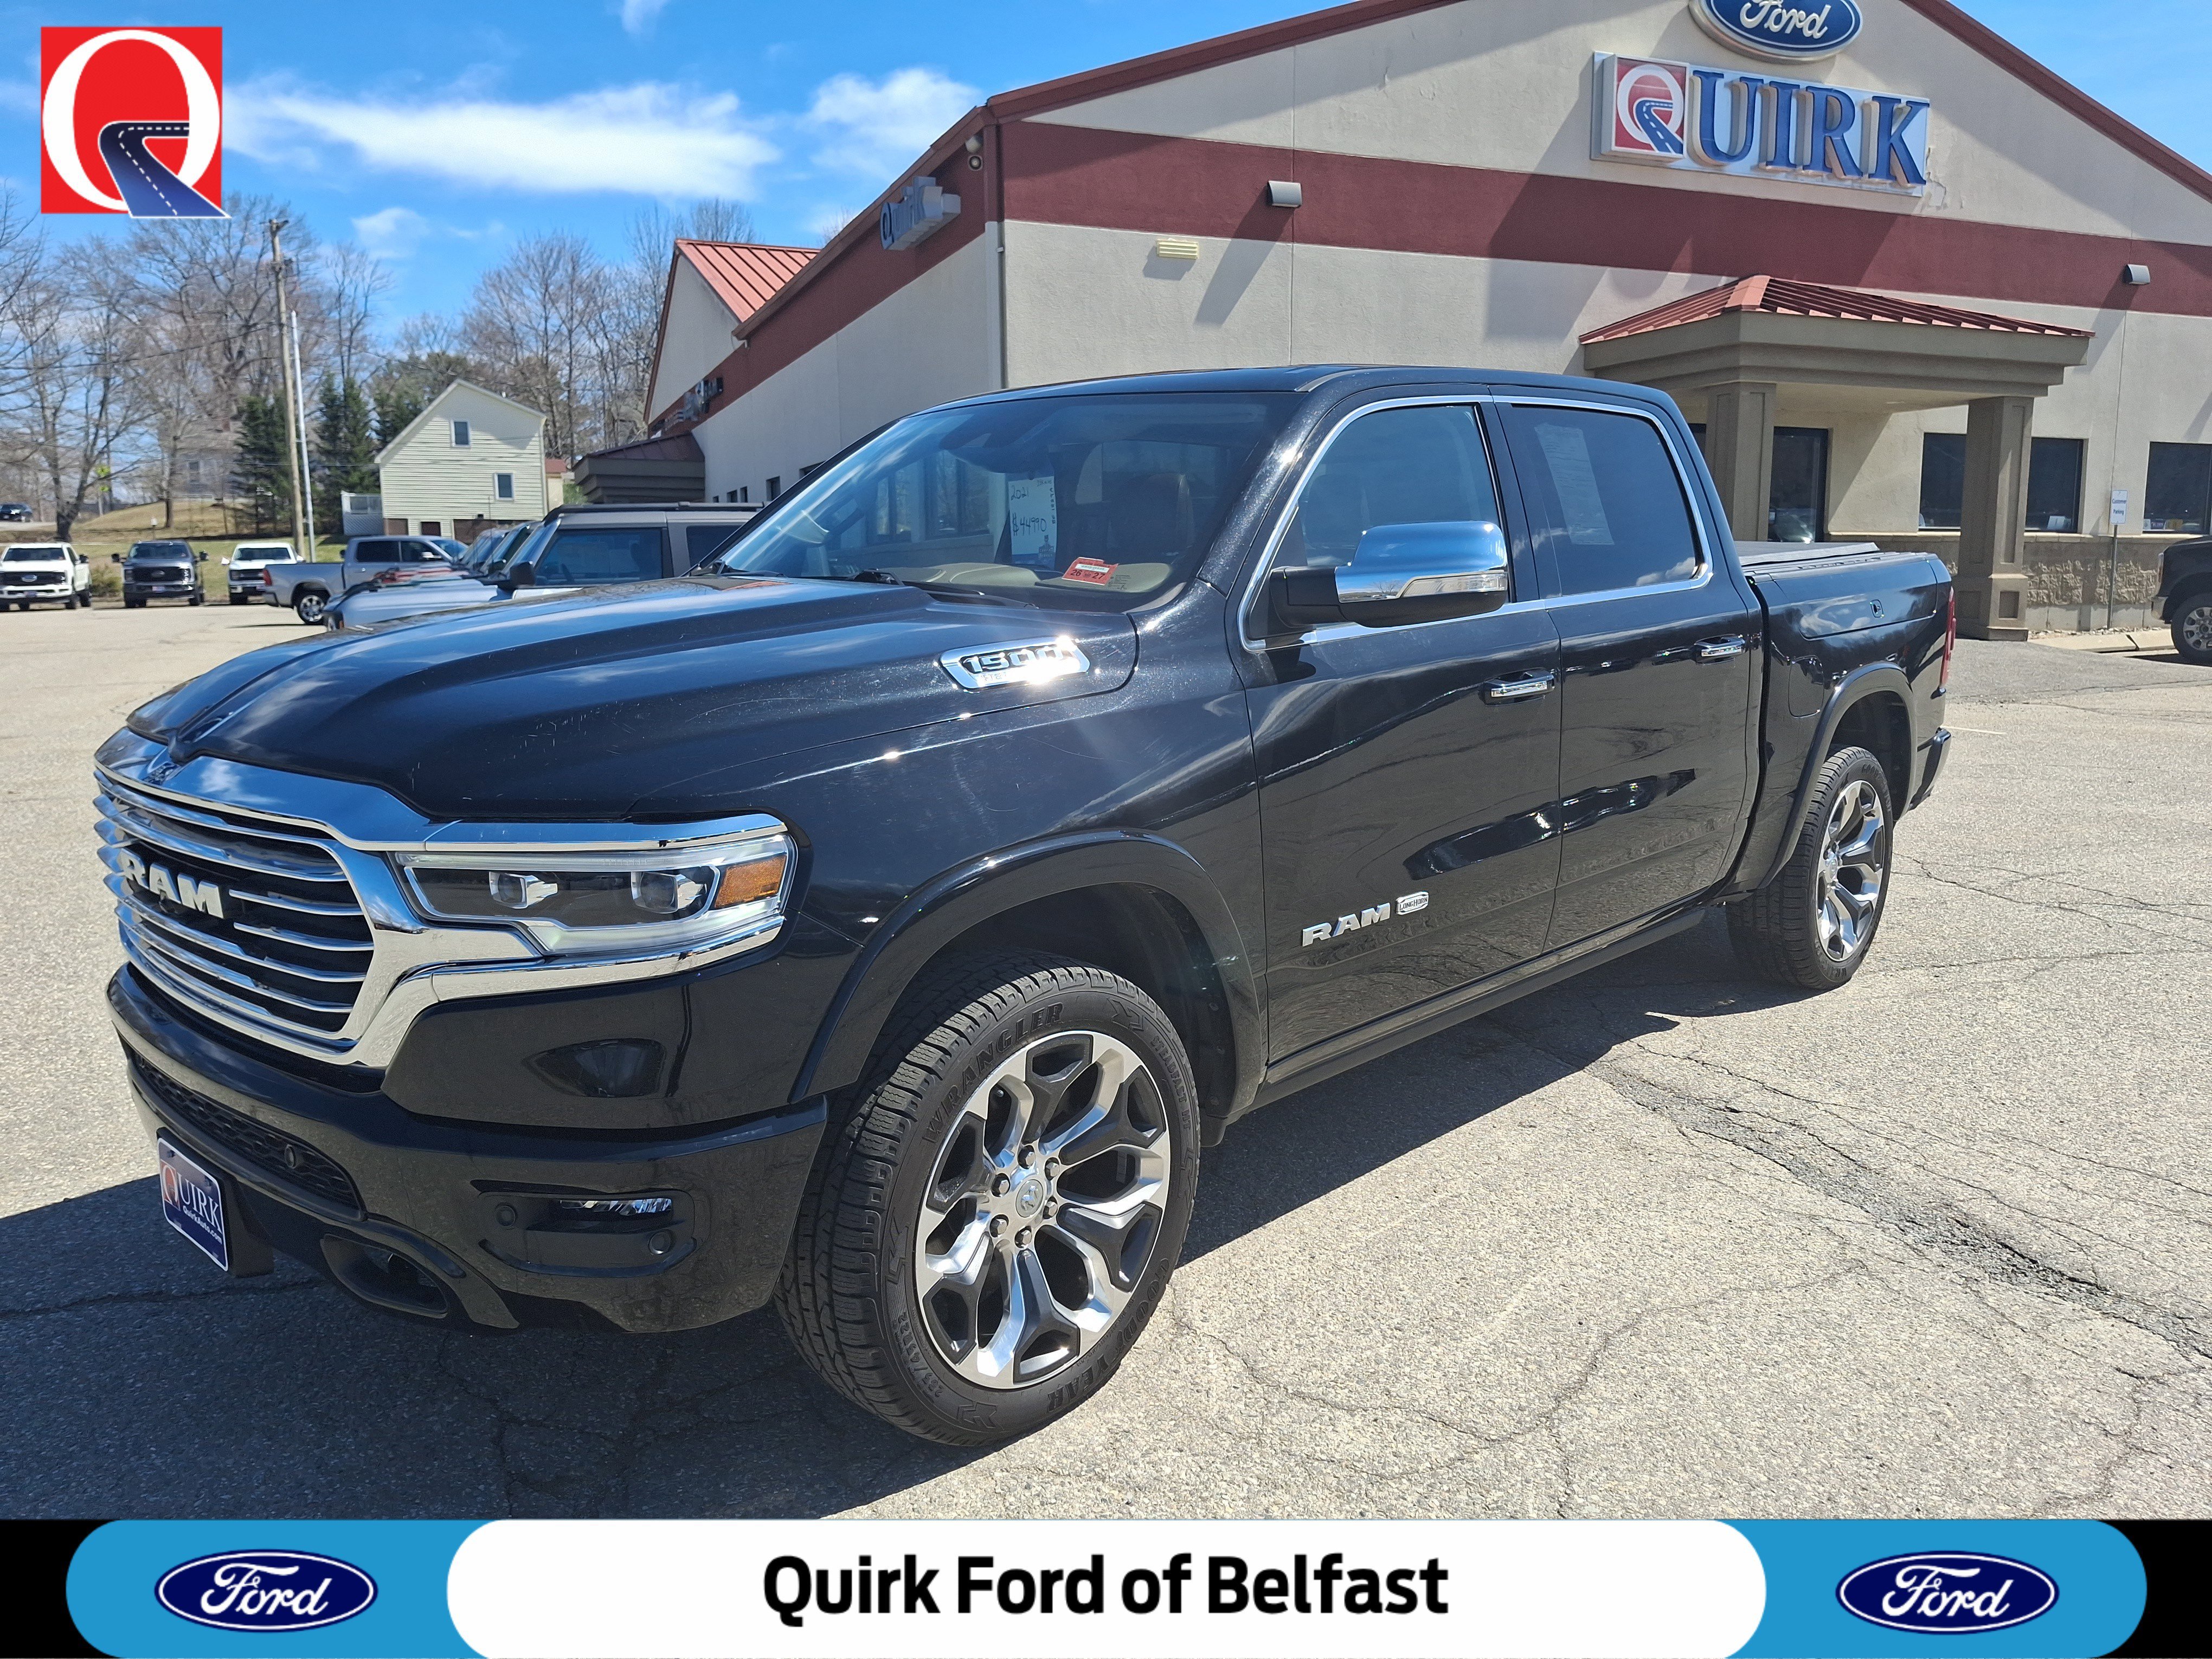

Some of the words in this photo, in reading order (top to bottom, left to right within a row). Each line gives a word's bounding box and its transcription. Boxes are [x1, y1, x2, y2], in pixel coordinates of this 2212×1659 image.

[1012, 512, 1047, 537] $44990
[119, 848, 223, 918] RAM
[1399, 896, 1428, 912] LONGHORN
[1302, 902, 1391, 947] RAM
[922, 1002, 1064, 1143] WRANGLER
[1150, 1034, 1187, 1104] STEADFAST
